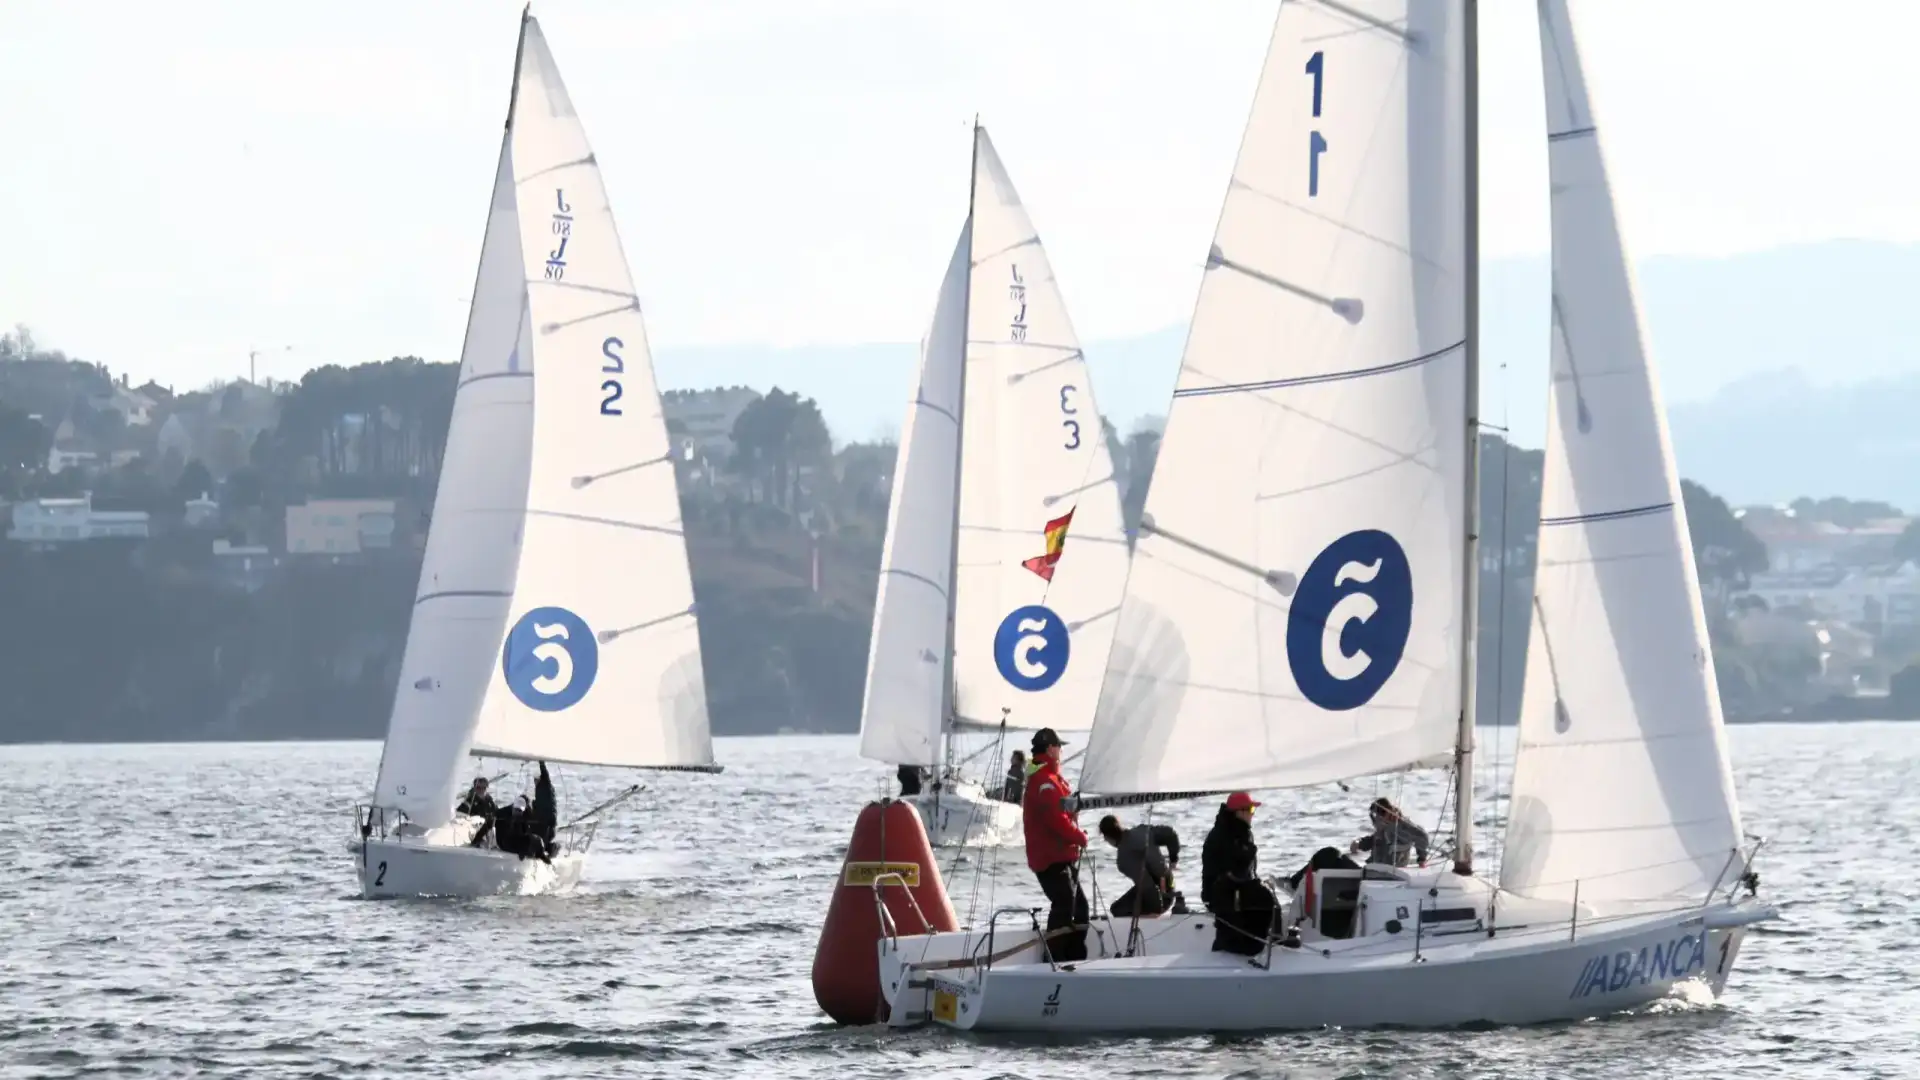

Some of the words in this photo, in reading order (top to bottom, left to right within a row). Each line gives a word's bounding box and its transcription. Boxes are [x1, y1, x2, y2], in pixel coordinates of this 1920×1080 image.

[1305, 51, 1324, 118] 1
[550, 238, 568, 260] J
[544, 266, 564, 281] 80
[1014, 303, 1027, 323] J
[600, 380, 623, 416] 2
[1063, 420, 1080, 450] 3
[375, 861, 387, 886] 2
[1716, 933, 1732, 974] 1
[1048, 983, 1062, 1001] J
